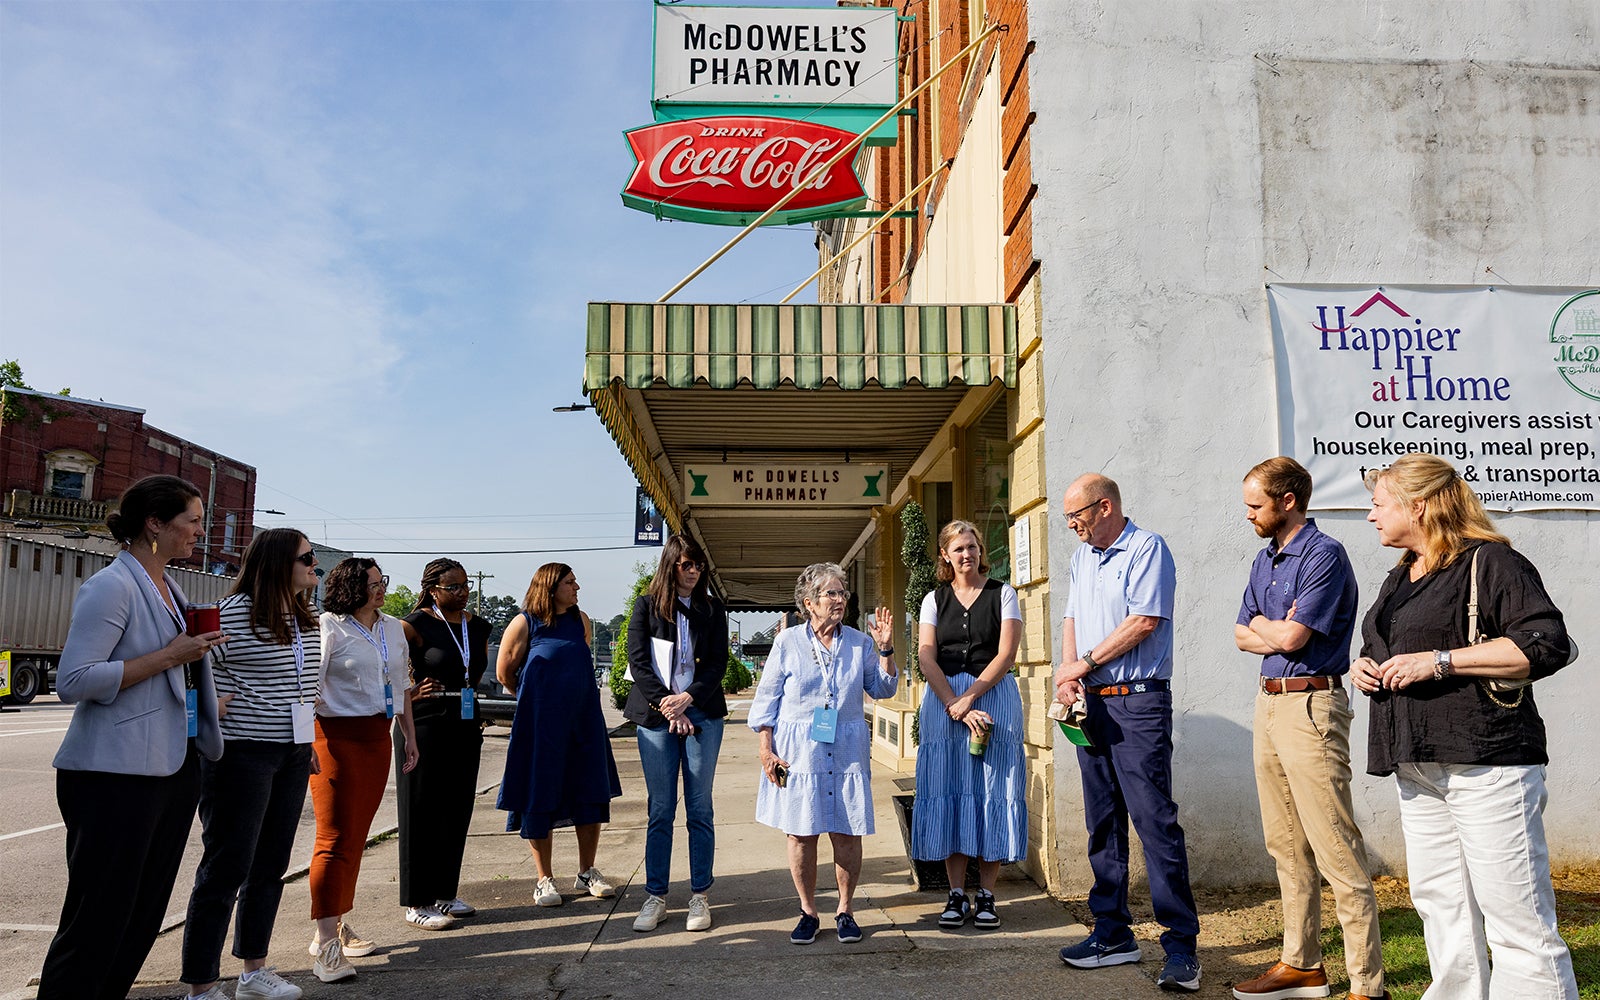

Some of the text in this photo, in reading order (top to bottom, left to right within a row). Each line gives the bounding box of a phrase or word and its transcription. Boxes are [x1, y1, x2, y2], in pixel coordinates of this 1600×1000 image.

[684, 24, 867, 54] McDOWELL'S
[690, 58, 861, 87] PHARMACY
[699, 127, 765, 138] DRINK
[1314, 305, 1462, 370] Happier
[1372, 355, 1511, 402] at Home
[1354, 411, 1593, 433] Our Caregivers assist
[1312, 437, 1596, 460] housekeeping, meal prep,
[733, 469, 840, 483] MC DOWELLS
[1464, 465, 1480, 482] &
[744, 487, 827, 501] PHARMACY
[1475, 490, 1594, 504] ppierAtHome.com
